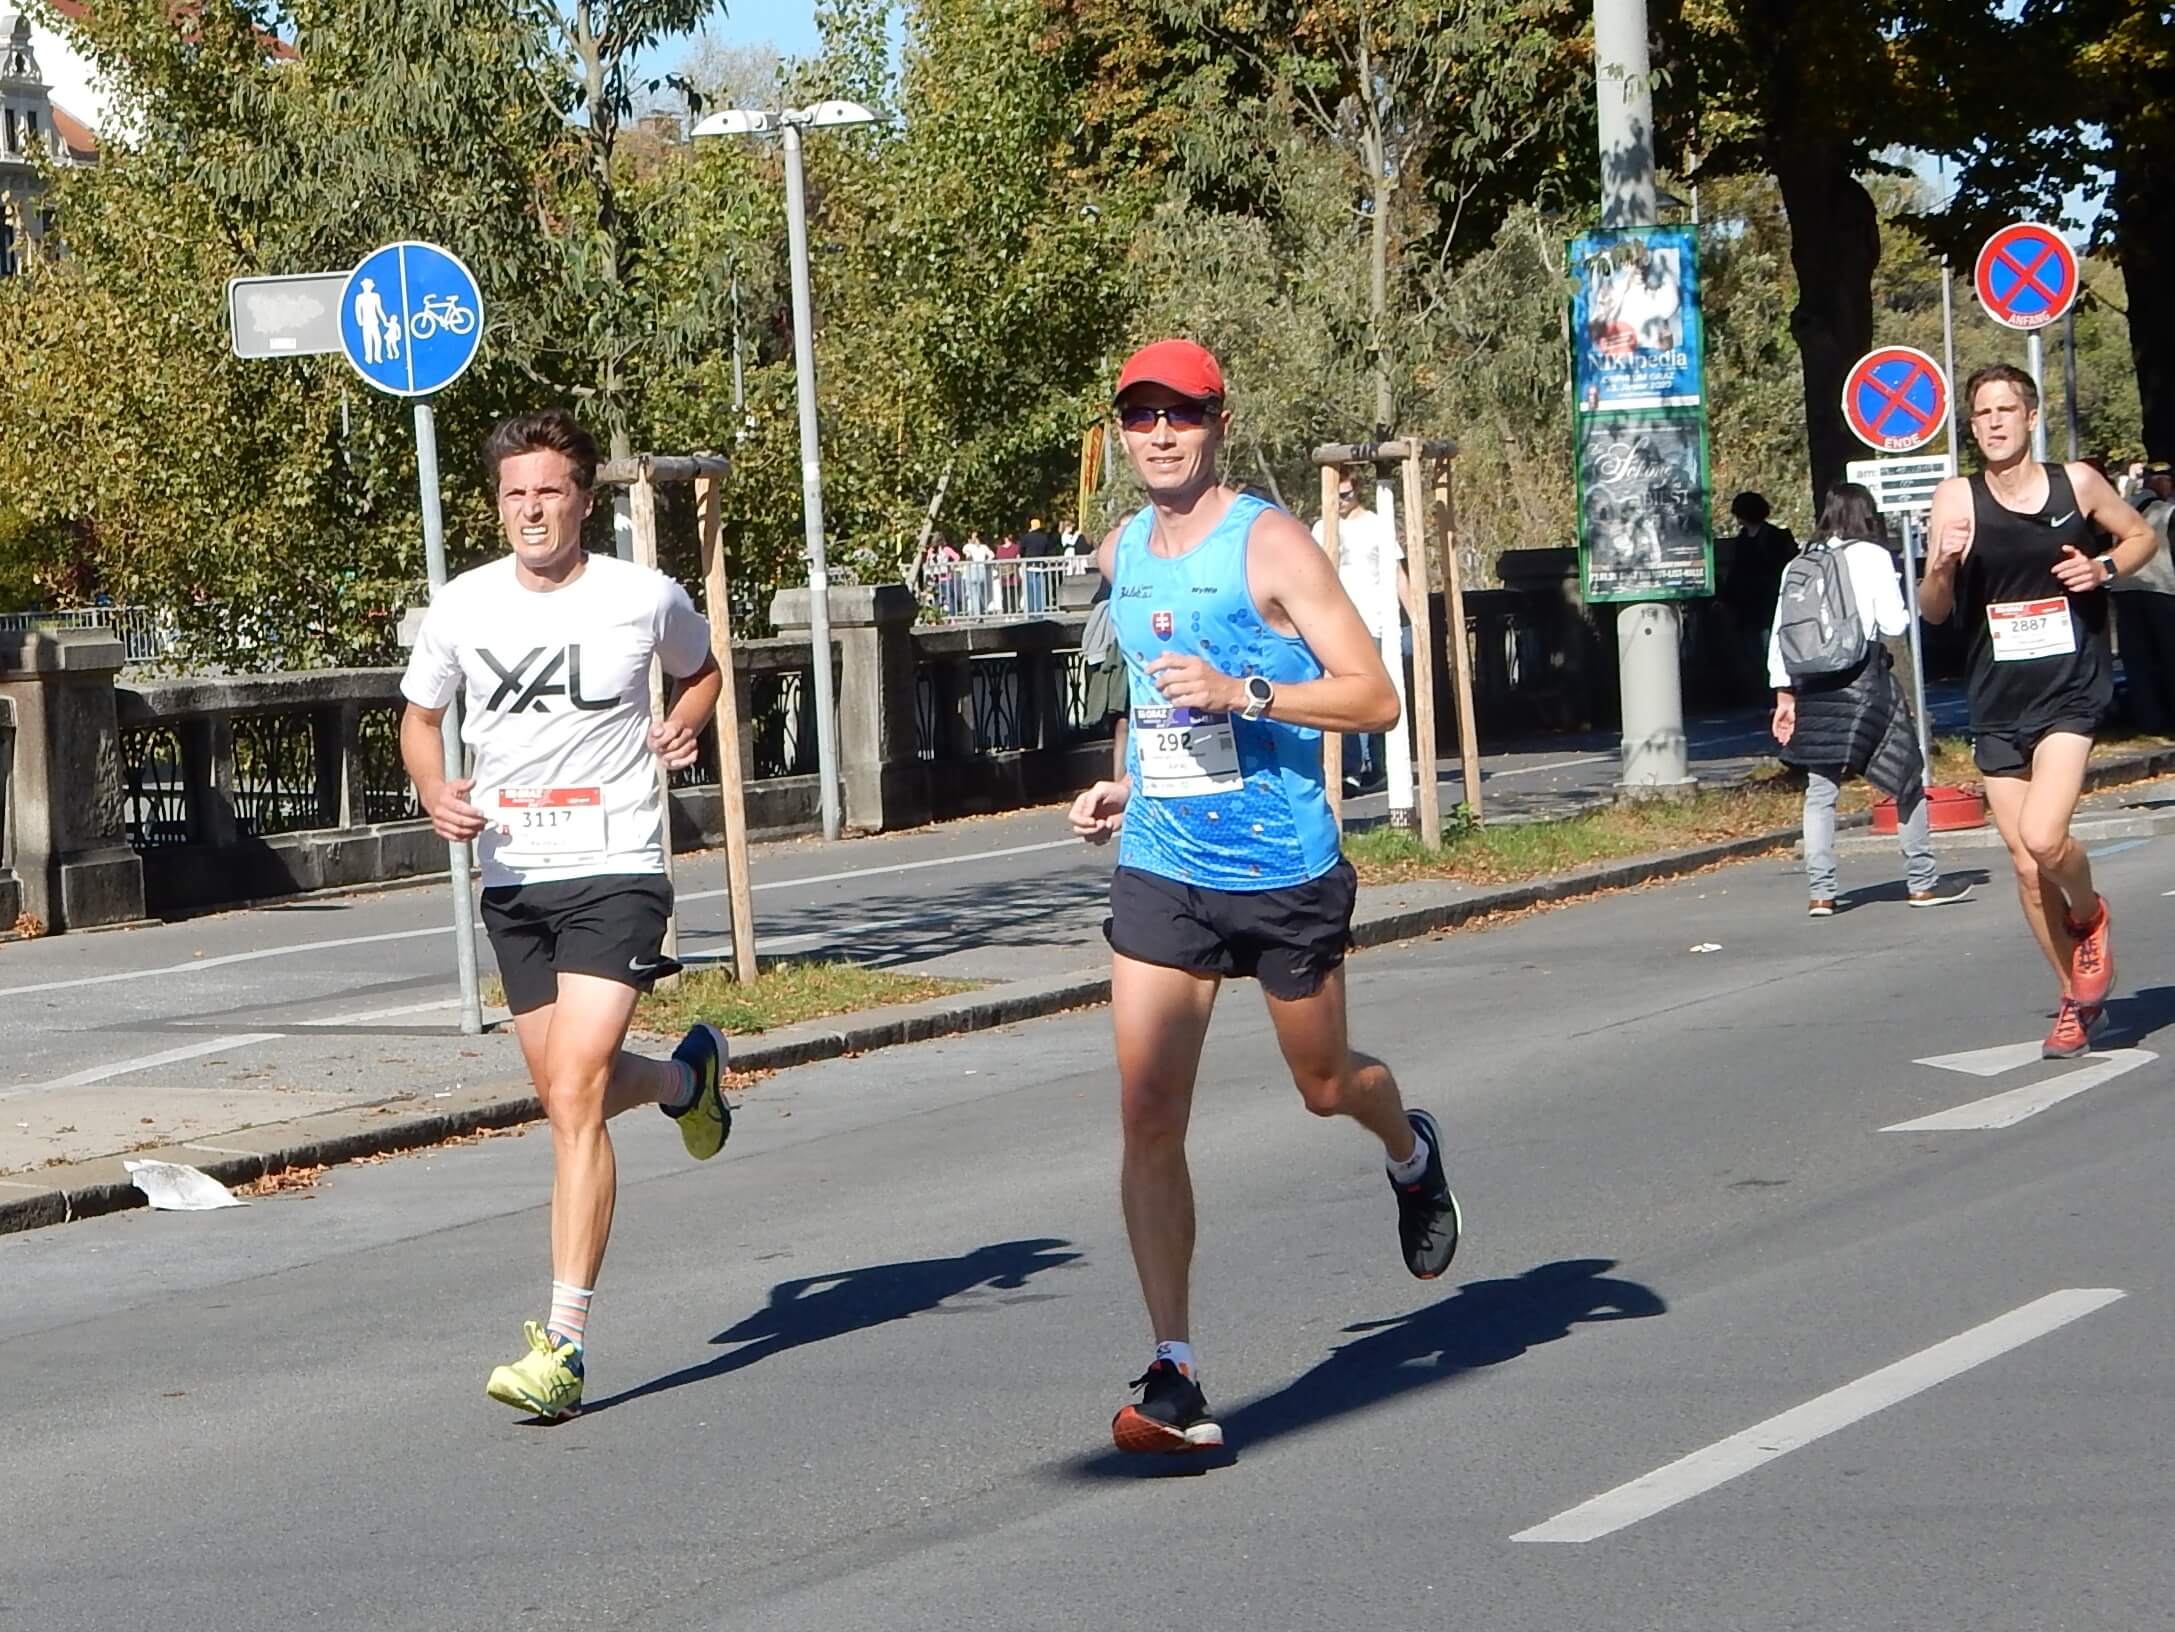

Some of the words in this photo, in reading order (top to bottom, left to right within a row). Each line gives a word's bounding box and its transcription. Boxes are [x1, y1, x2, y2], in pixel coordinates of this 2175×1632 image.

[2007, 310, 2051, 326] ANFANG
[1884, 432, 1921, 449] ENDE
[2011, 617, 2047, 633] 2887
[522, 810, 573, 828] 3117
